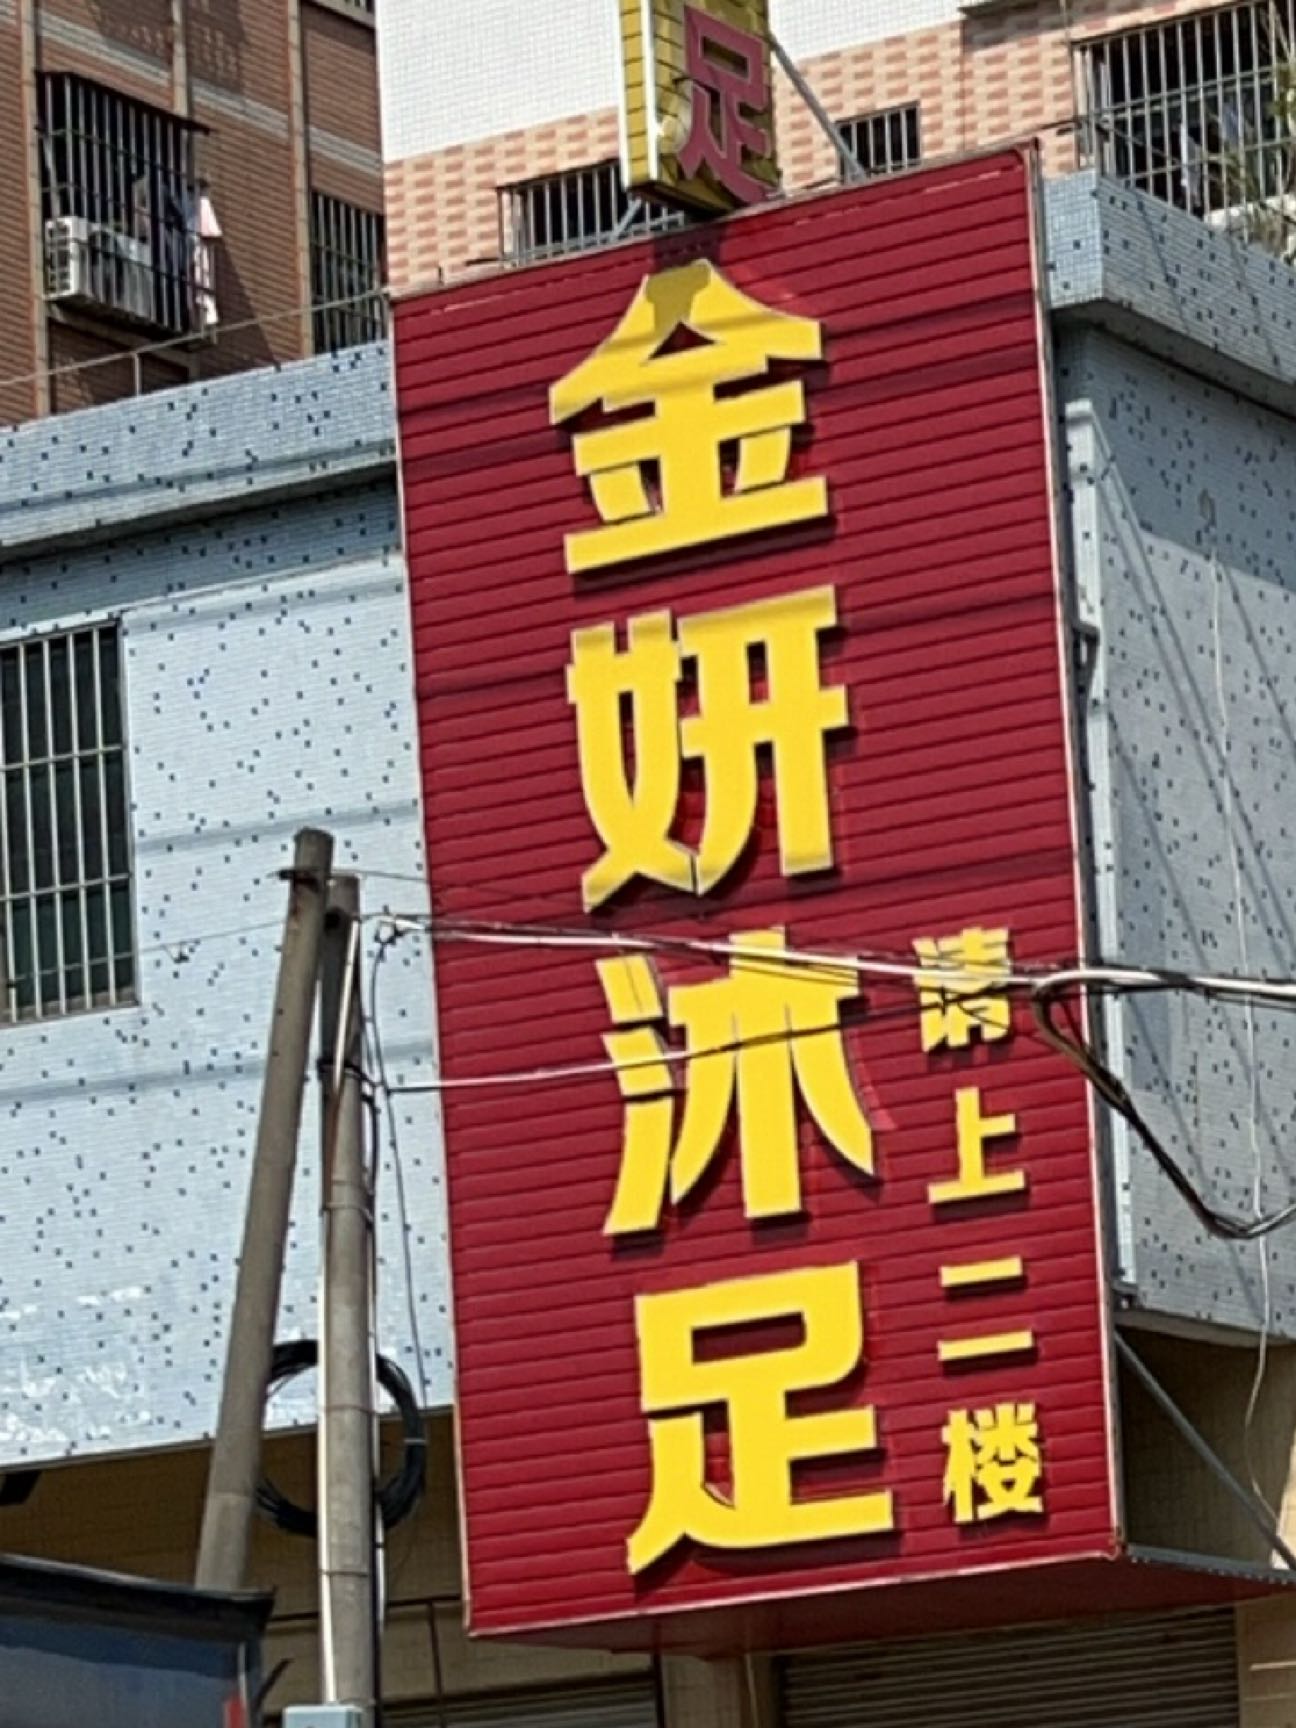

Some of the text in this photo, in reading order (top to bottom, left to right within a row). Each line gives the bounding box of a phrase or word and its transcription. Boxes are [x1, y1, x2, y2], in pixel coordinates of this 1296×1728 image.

[677, 3, 776, 205] 足
[549, 258, 896, 1576] 金妍沐足
